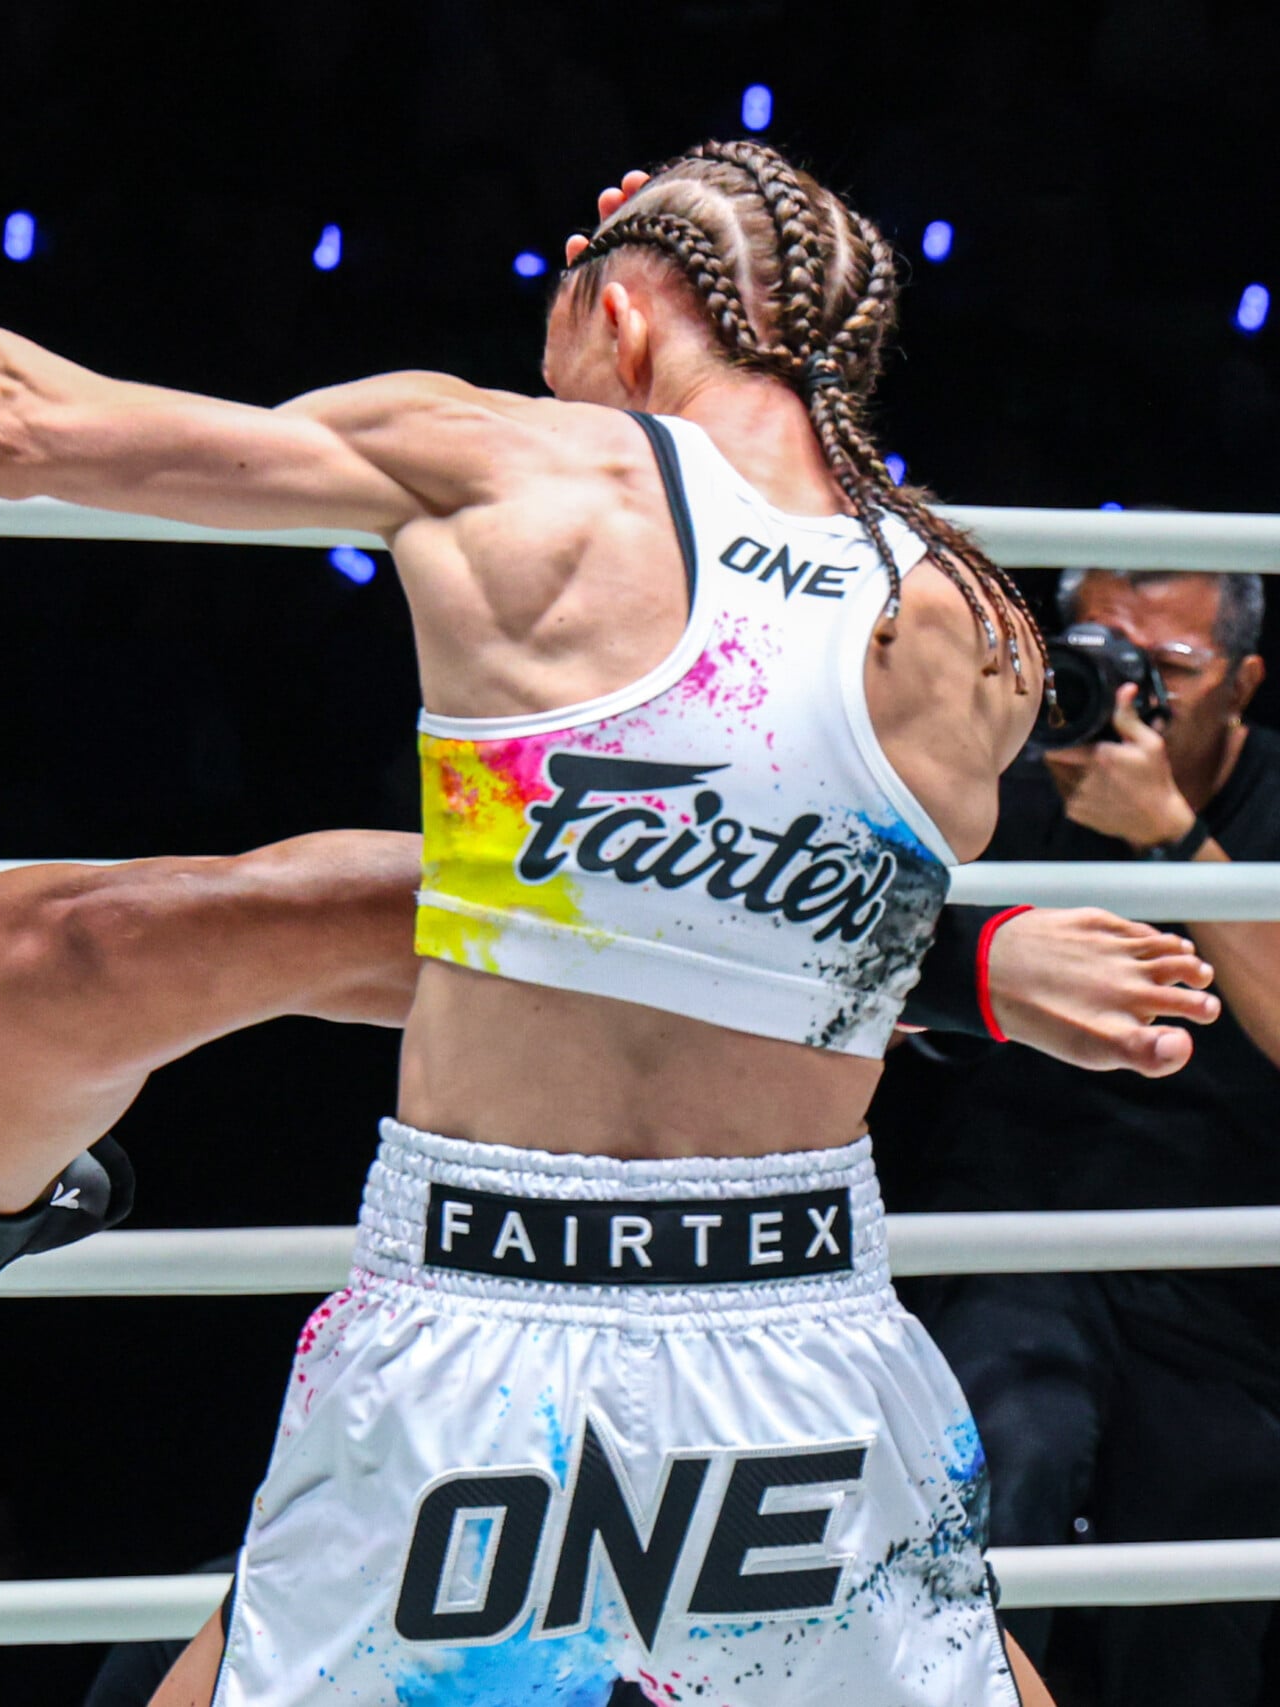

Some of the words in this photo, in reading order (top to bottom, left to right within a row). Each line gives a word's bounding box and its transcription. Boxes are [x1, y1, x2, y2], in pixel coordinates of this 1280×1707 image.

[719, 536, 859, 600] ONE
[516, 752, 896, 944] Fairtex
[439, 1200, 841, 1269] FAIRTEX
[394, 1408, 875, 1656] ONE
